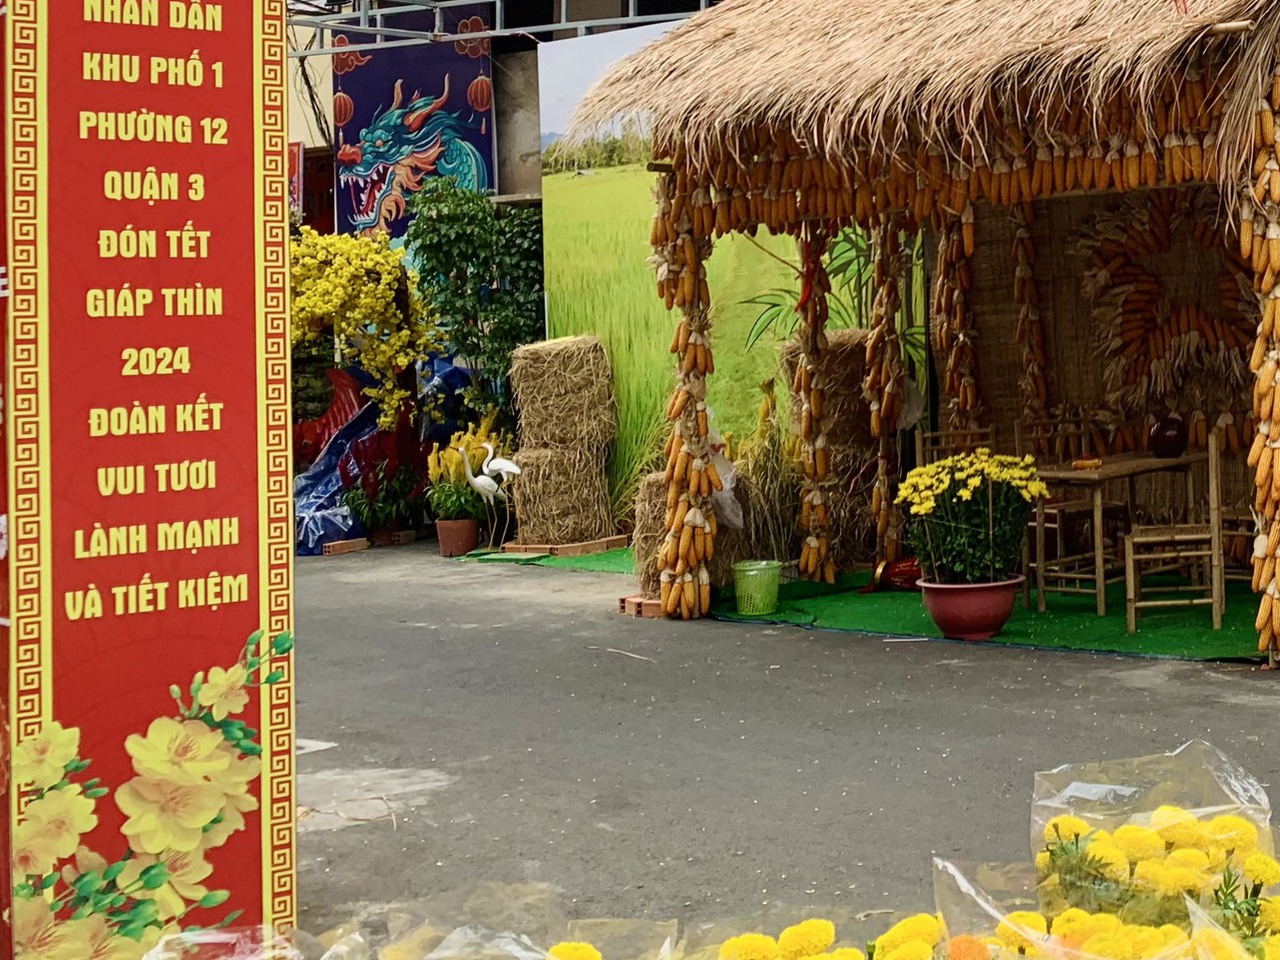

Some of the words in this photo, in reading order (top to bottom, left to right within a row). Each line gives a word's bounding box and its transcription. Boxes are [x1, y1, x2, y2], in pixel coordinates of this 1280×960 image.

[83, 52, 140, 83] KHU
[150, 49, 203, 88] PHỐ
[211, 62, 223, 88] 1
[79, 108, 192, 143] PHƯỜNG
[201, 118, 228, 145] 12
[104, 166, 179, 206] QUẬN
[188, 174, 205, 201] 3
[98, 224, 156, 258] ĐÓN
[166, 220, 211, 258] TẾT
[86, 283, 153, 318] GIÁP
[161, 283, 223, 316] THÌN
[121, 346, 190, 376] 2024
[88, 401, 166, 436] ĐOÀN
[176, 392, 224, 432] KẾT
[97, 465, 145, 496] VUI
[155, 459, 216, 492] TƯƠI
[74, 523, 147, 559] LÀNH
[157, 517, 239, 554] MẠNH
[65, 584, 103, 620] VÀ
[112, 573, 169, 615] TIẾT
[178, 571, 248, 611] KIỆM
